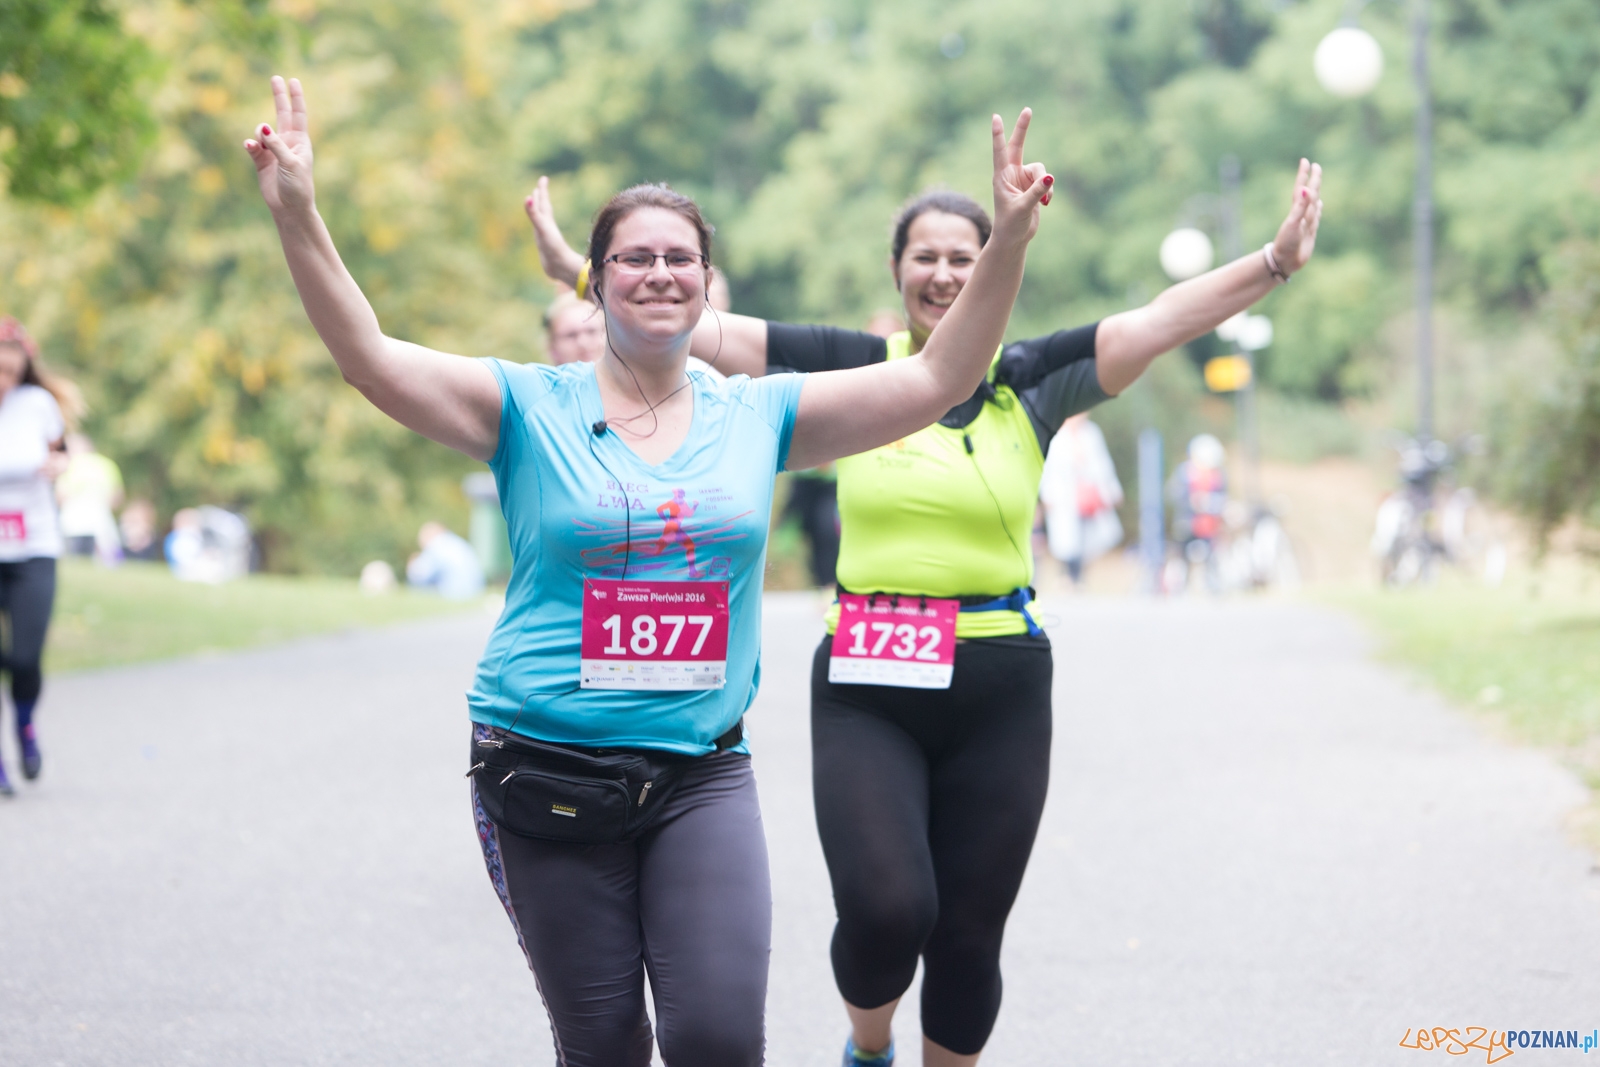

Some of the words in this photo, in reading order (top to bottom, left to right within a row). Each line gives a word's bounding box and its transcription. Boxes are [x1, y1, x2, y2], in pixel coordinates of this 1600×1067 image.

[606, 480, 649, 493] BIEG
[596, 493, 646, 510] LWA
[617, 592, 649, 602] Zawsze
[650, 592, 683, 603] Pier(w)si
[685, 592, 706, 602] 2016
[602, 614, 713, 656] 1877
[848, 621, 942, 661] 1732
